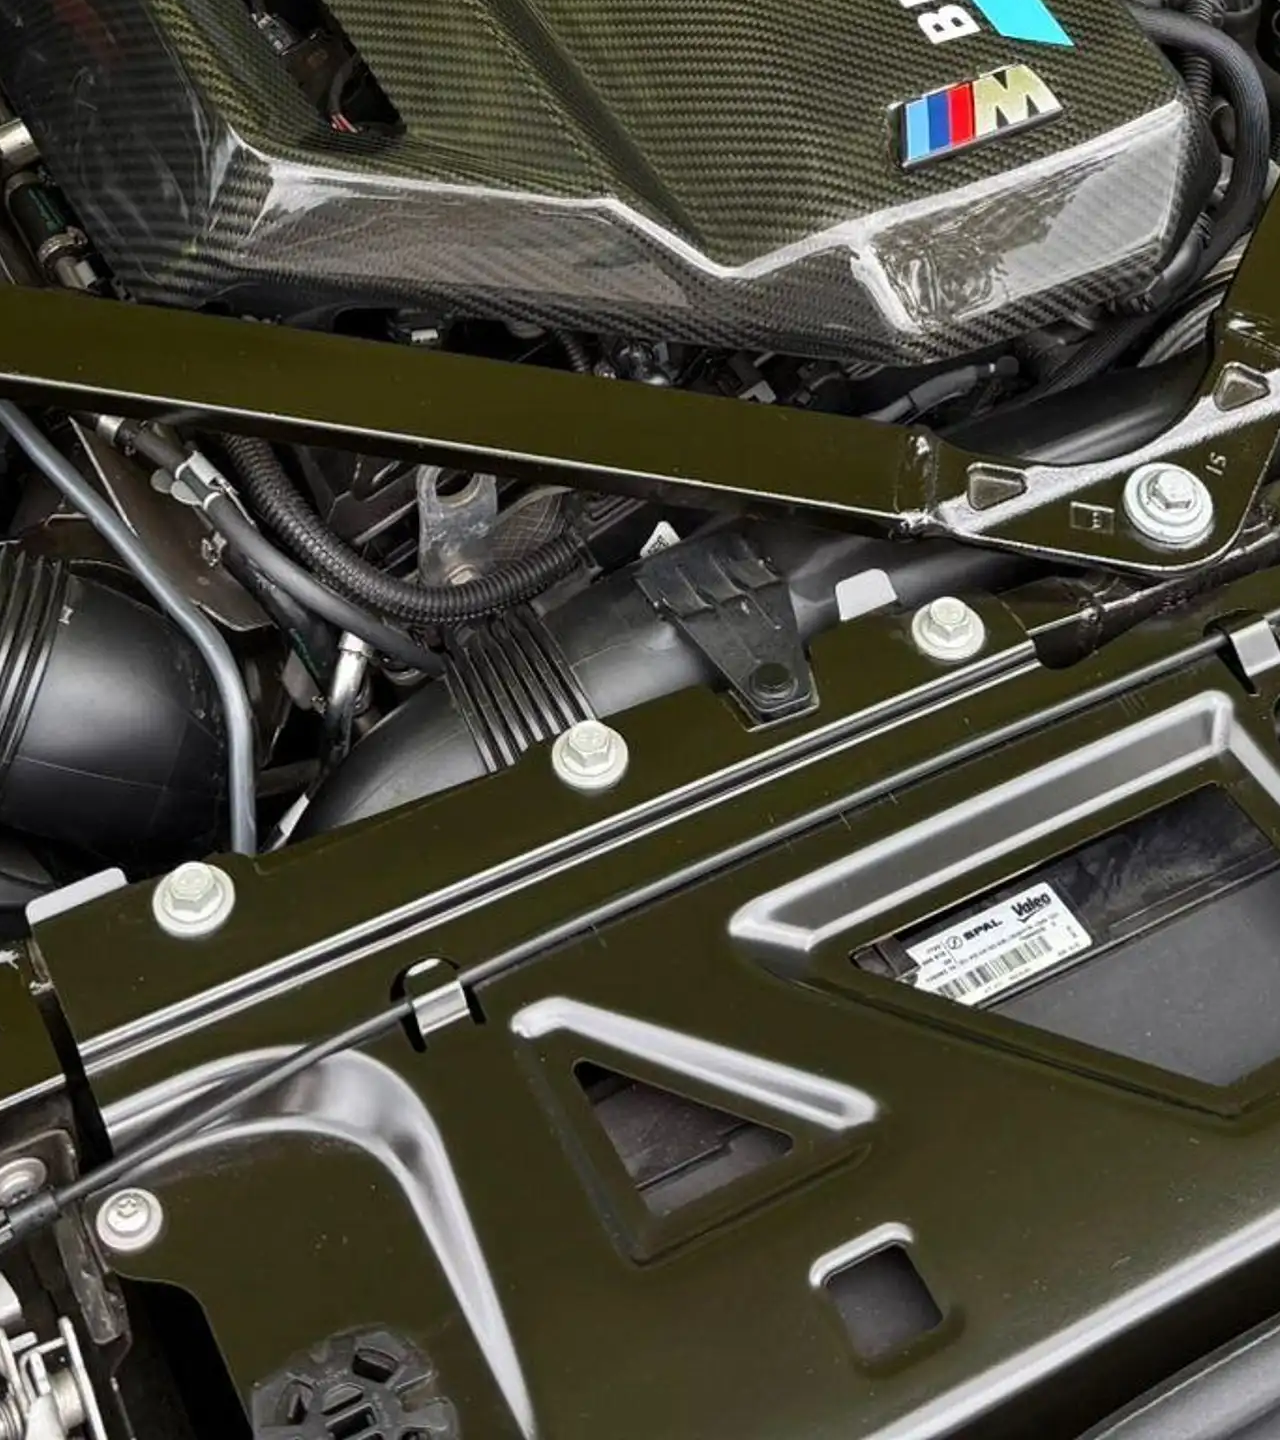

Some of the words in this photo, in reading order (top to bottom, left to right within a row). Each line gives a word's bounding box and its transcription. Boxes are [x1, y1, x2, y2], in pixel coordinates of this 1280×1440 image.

[971, 63, 1062, 138] M
[1010, 892, 1052, 917] Valeo
[962, 918, 1003, 941] SPAL
